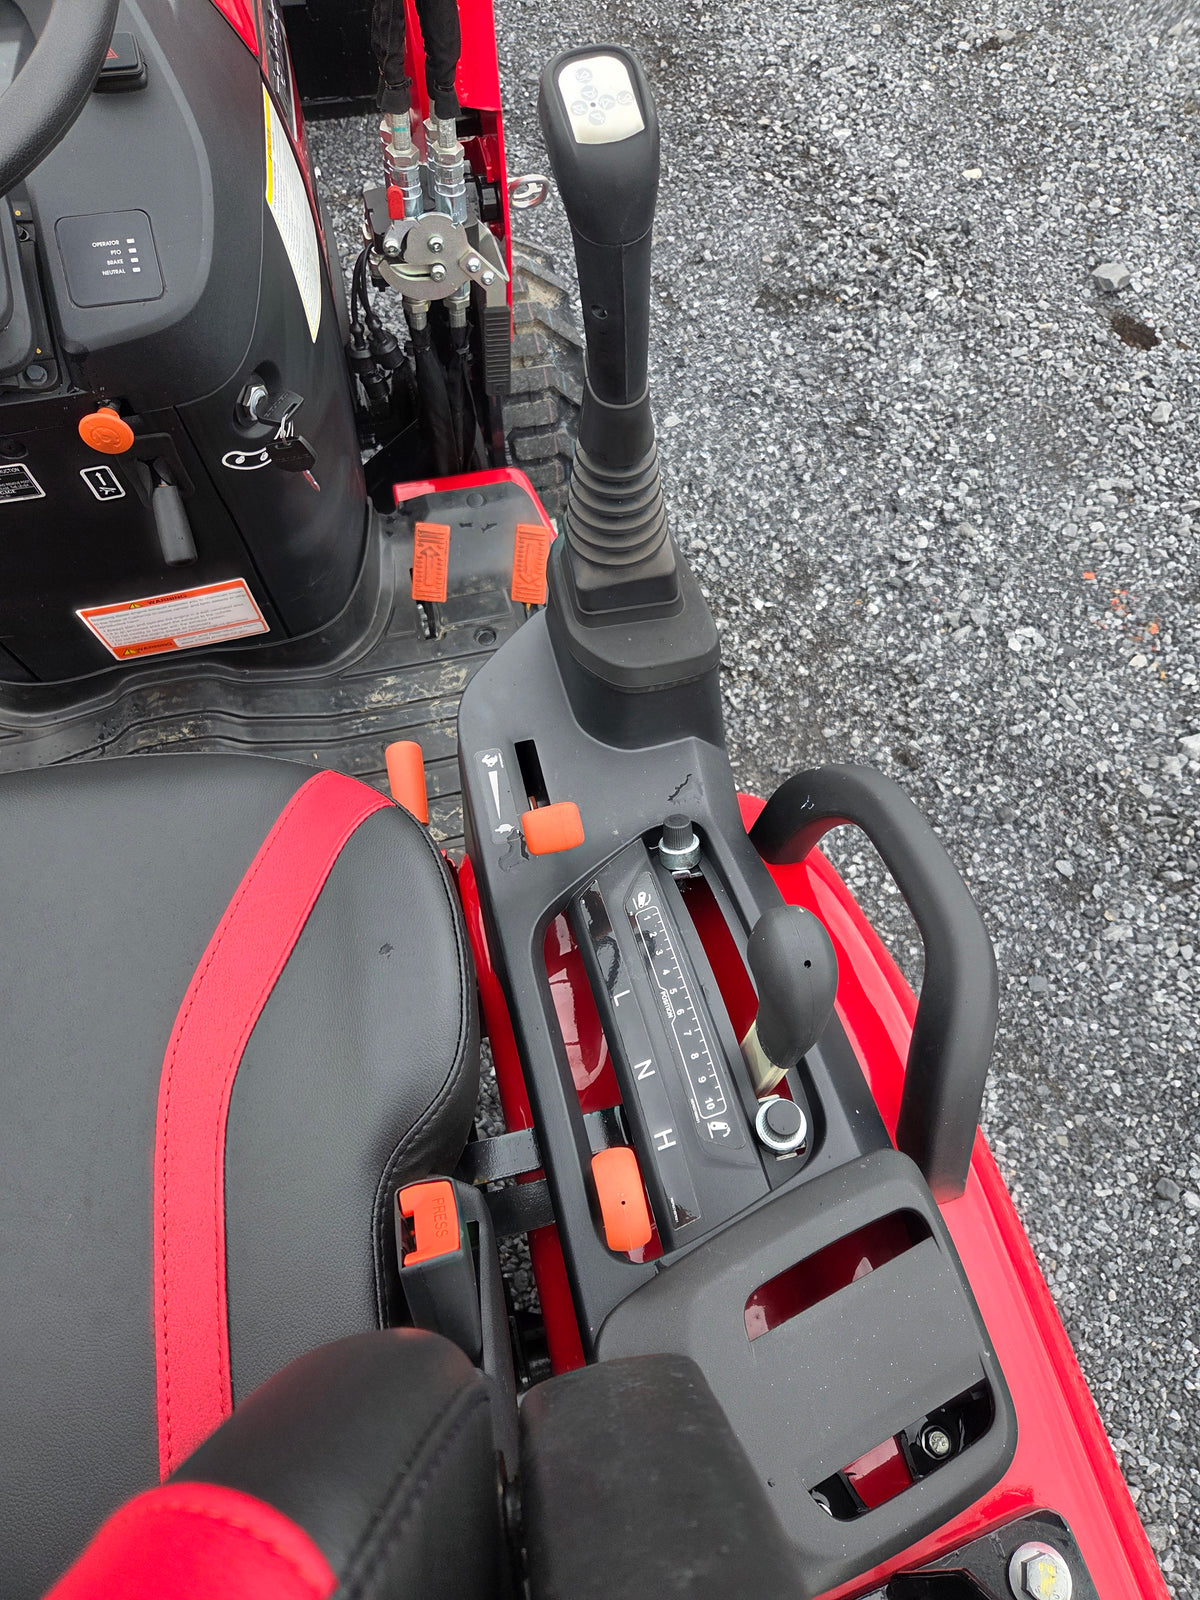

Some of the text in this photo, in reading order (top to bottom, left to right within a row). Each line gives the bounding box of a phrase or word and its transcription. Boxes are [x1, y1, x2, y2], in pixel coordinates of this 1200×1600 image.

[92, 240, 120, 248] OPERATOR
[102, 268, 126, 276] NEUTRAL
[148, 594, 188, 605] WARNING
[613, 989, 631, 1007] L
[660, 991, 674, 1019] POSITION
[662, 968, 671, 976] 4
[677, 1008, 685, 1016] 6
[683, 1029, 692, 1037] 7
[690, 1052, 700, 1060] 8
[698, 1075, 707, 1084] 9
[704, 1097, 716, 1111] 10
[634, 1059, 656, 1081] N
[653, 1128, 677, 1151] H
[432, 1197, 449, 1239] PRESS
